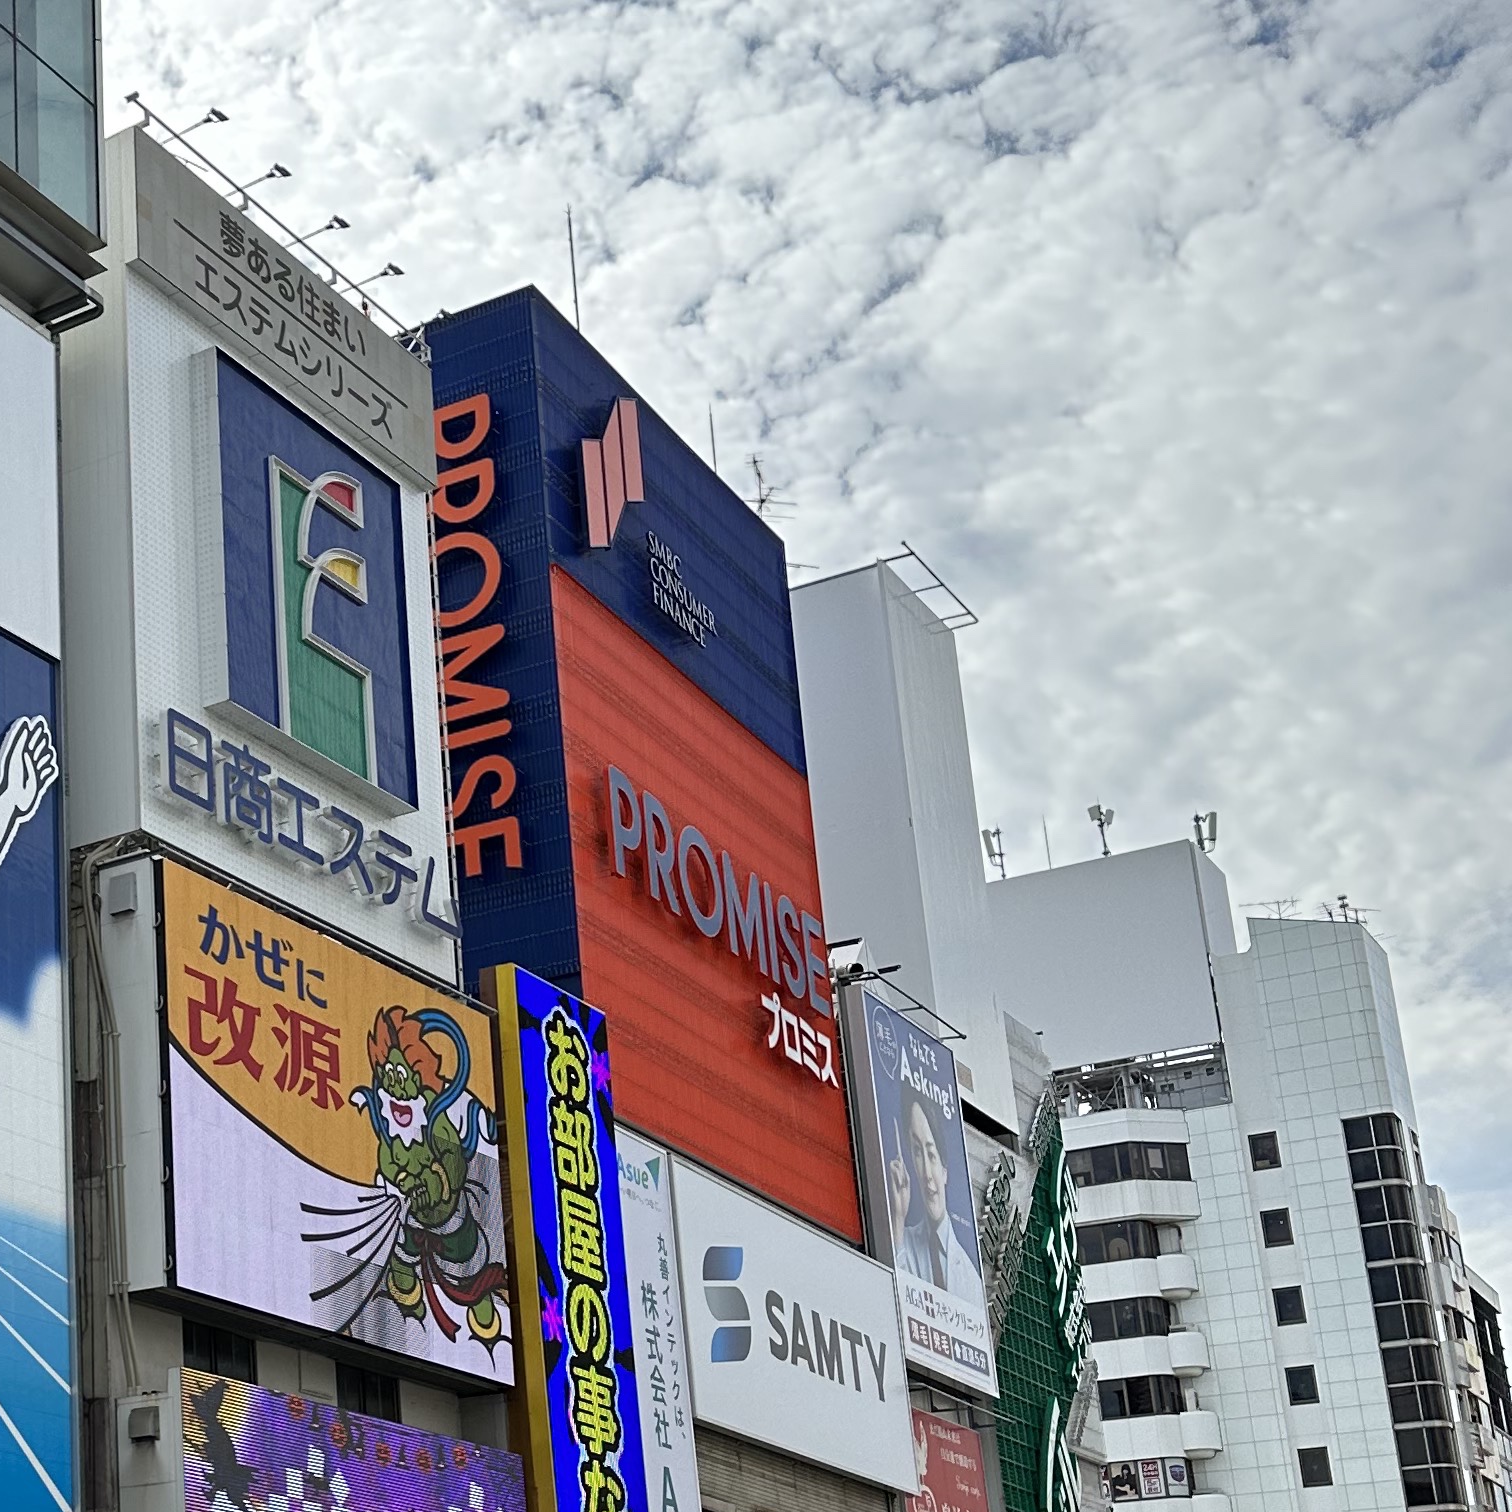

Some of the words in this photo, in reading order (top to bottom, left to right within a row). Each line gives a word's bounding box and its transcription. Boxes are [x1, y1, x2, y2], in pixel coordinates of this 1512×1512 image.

[219, 210, 366, 356] 夢ある住まい
[193, 253, 394, 439] エステムシリーズ
[647, 530, 682, 578] SMBC
[649, 556, 718, 636] CONSUMER
[652, 586, 707, 648] FINANCE
[607, 763, 830, 1019] PROMISE
[198, 904, 328, 1010] かぜに
[184, 965, 345, 1112] 改源
[760, 991, 839, 1089] プロミス
[900, 1046, 955, 1120] Asking!
[618, 1154, 649, 1190] Asue
[766, 1289, 888, 1401] SAMTY
[906, 1285, 924, 1311] AGA
[640, 1280, 672, 1449] 株式会社
